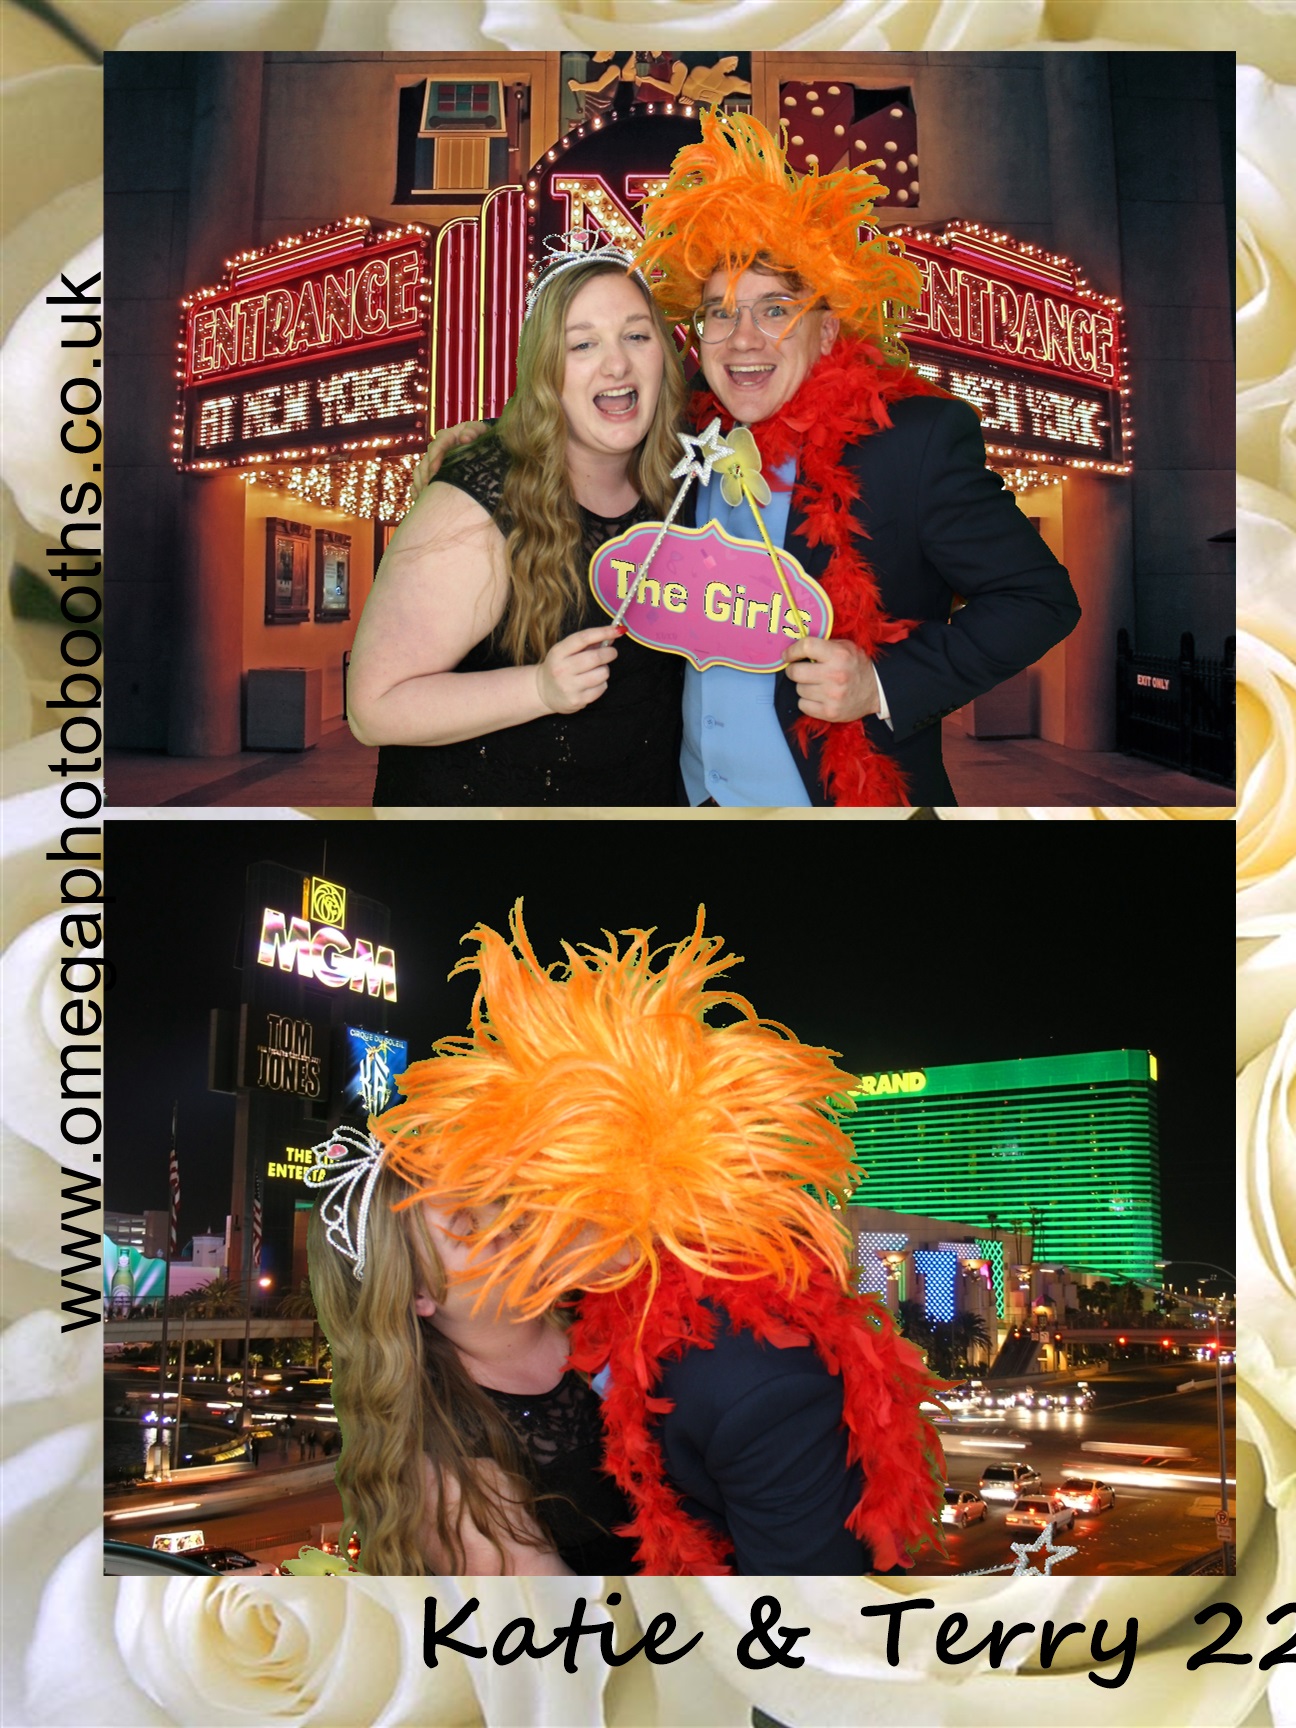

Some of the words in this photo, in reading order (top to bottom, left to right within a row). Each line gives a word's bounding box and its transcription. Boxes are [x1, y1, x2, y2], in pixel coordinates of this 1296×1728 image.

[192, 249, 420, 375] ENTRANCE
[611, 558, 689, 614] The
[704, 580, 812, 640] Girls
[1137, 674, 1151, 687] EXIT
[1152, 677, 1169, 690] ONLY
[257, 907, 398, 1003] MGM
[267, 1013, 313, 1056] TOM
[350, 1029, 373, 1042] CIRQUE
[374, 1035, 384, 1043] DU
[384, 1037, 405, 1049] SOLEIL
[257, 1051, 321, 1098] JONES
[286, 1147, 312, 1164] THE
